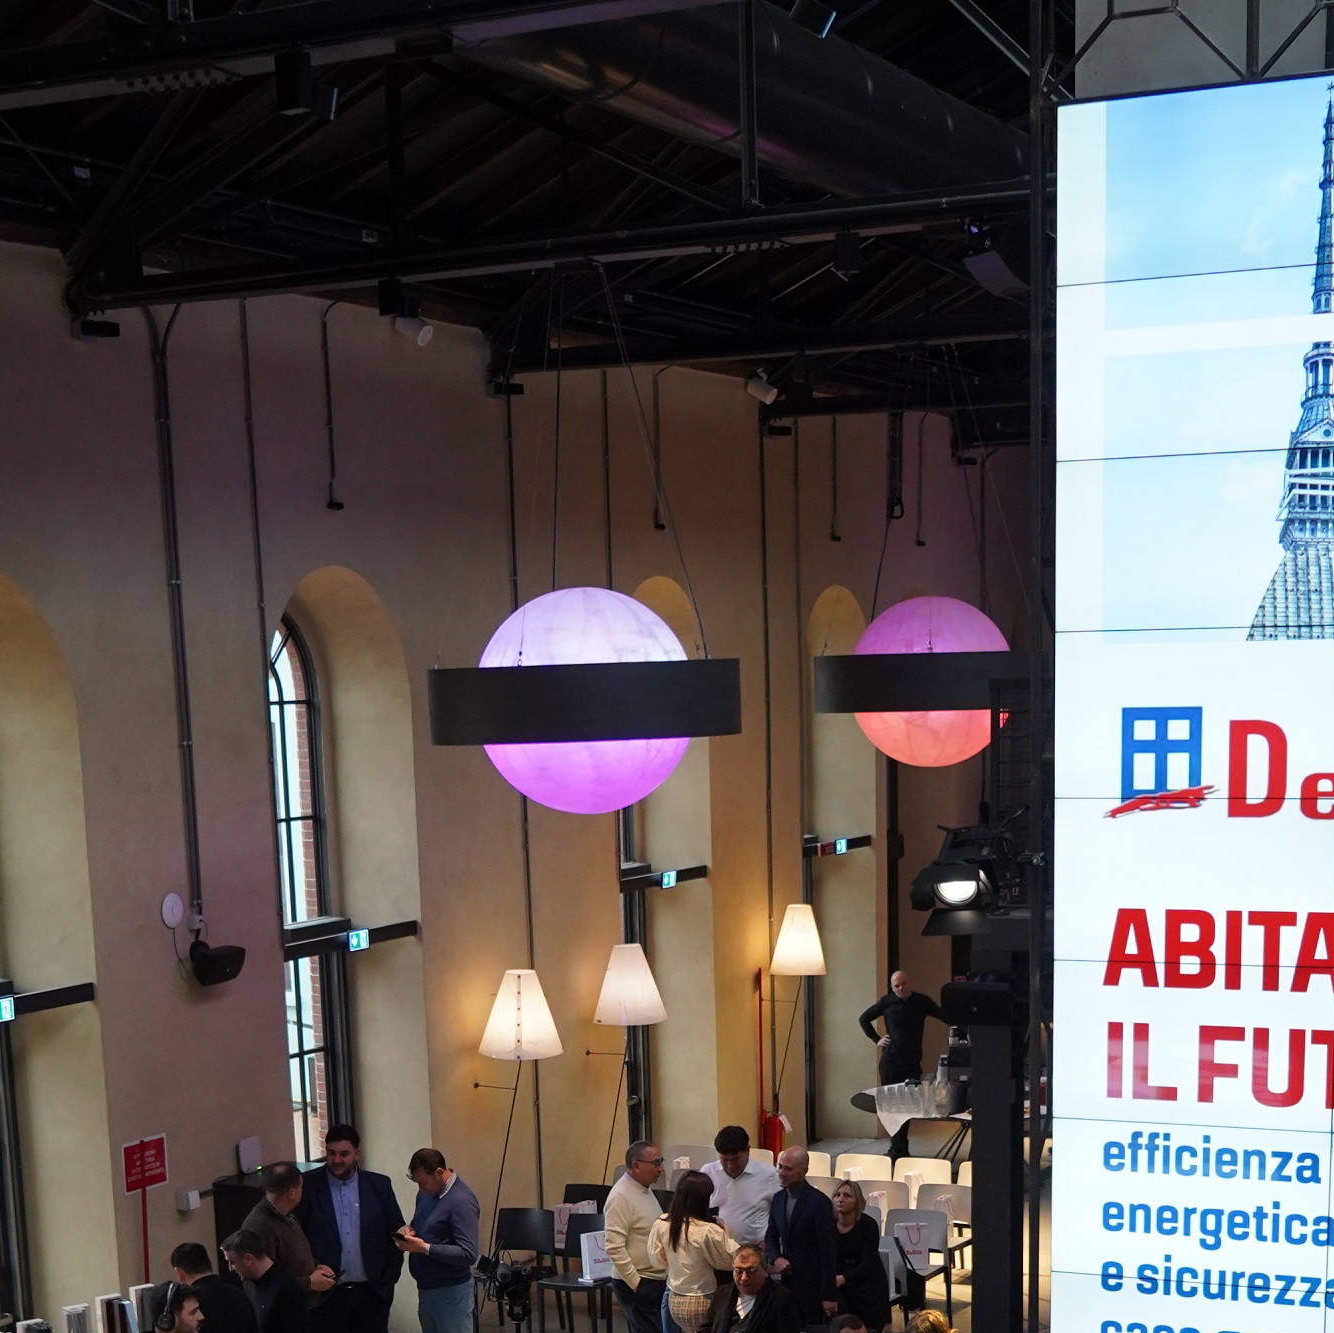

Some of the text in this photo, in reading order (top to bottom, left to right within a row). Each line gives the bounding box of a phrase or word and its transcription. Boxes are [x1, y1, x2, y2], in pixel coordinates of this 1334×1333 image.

[1107, 1021, 1178, 1102] IL
[1102, 1131, 1322, 1184] efficienza
[1100, 1260, 1124, 1292] e
